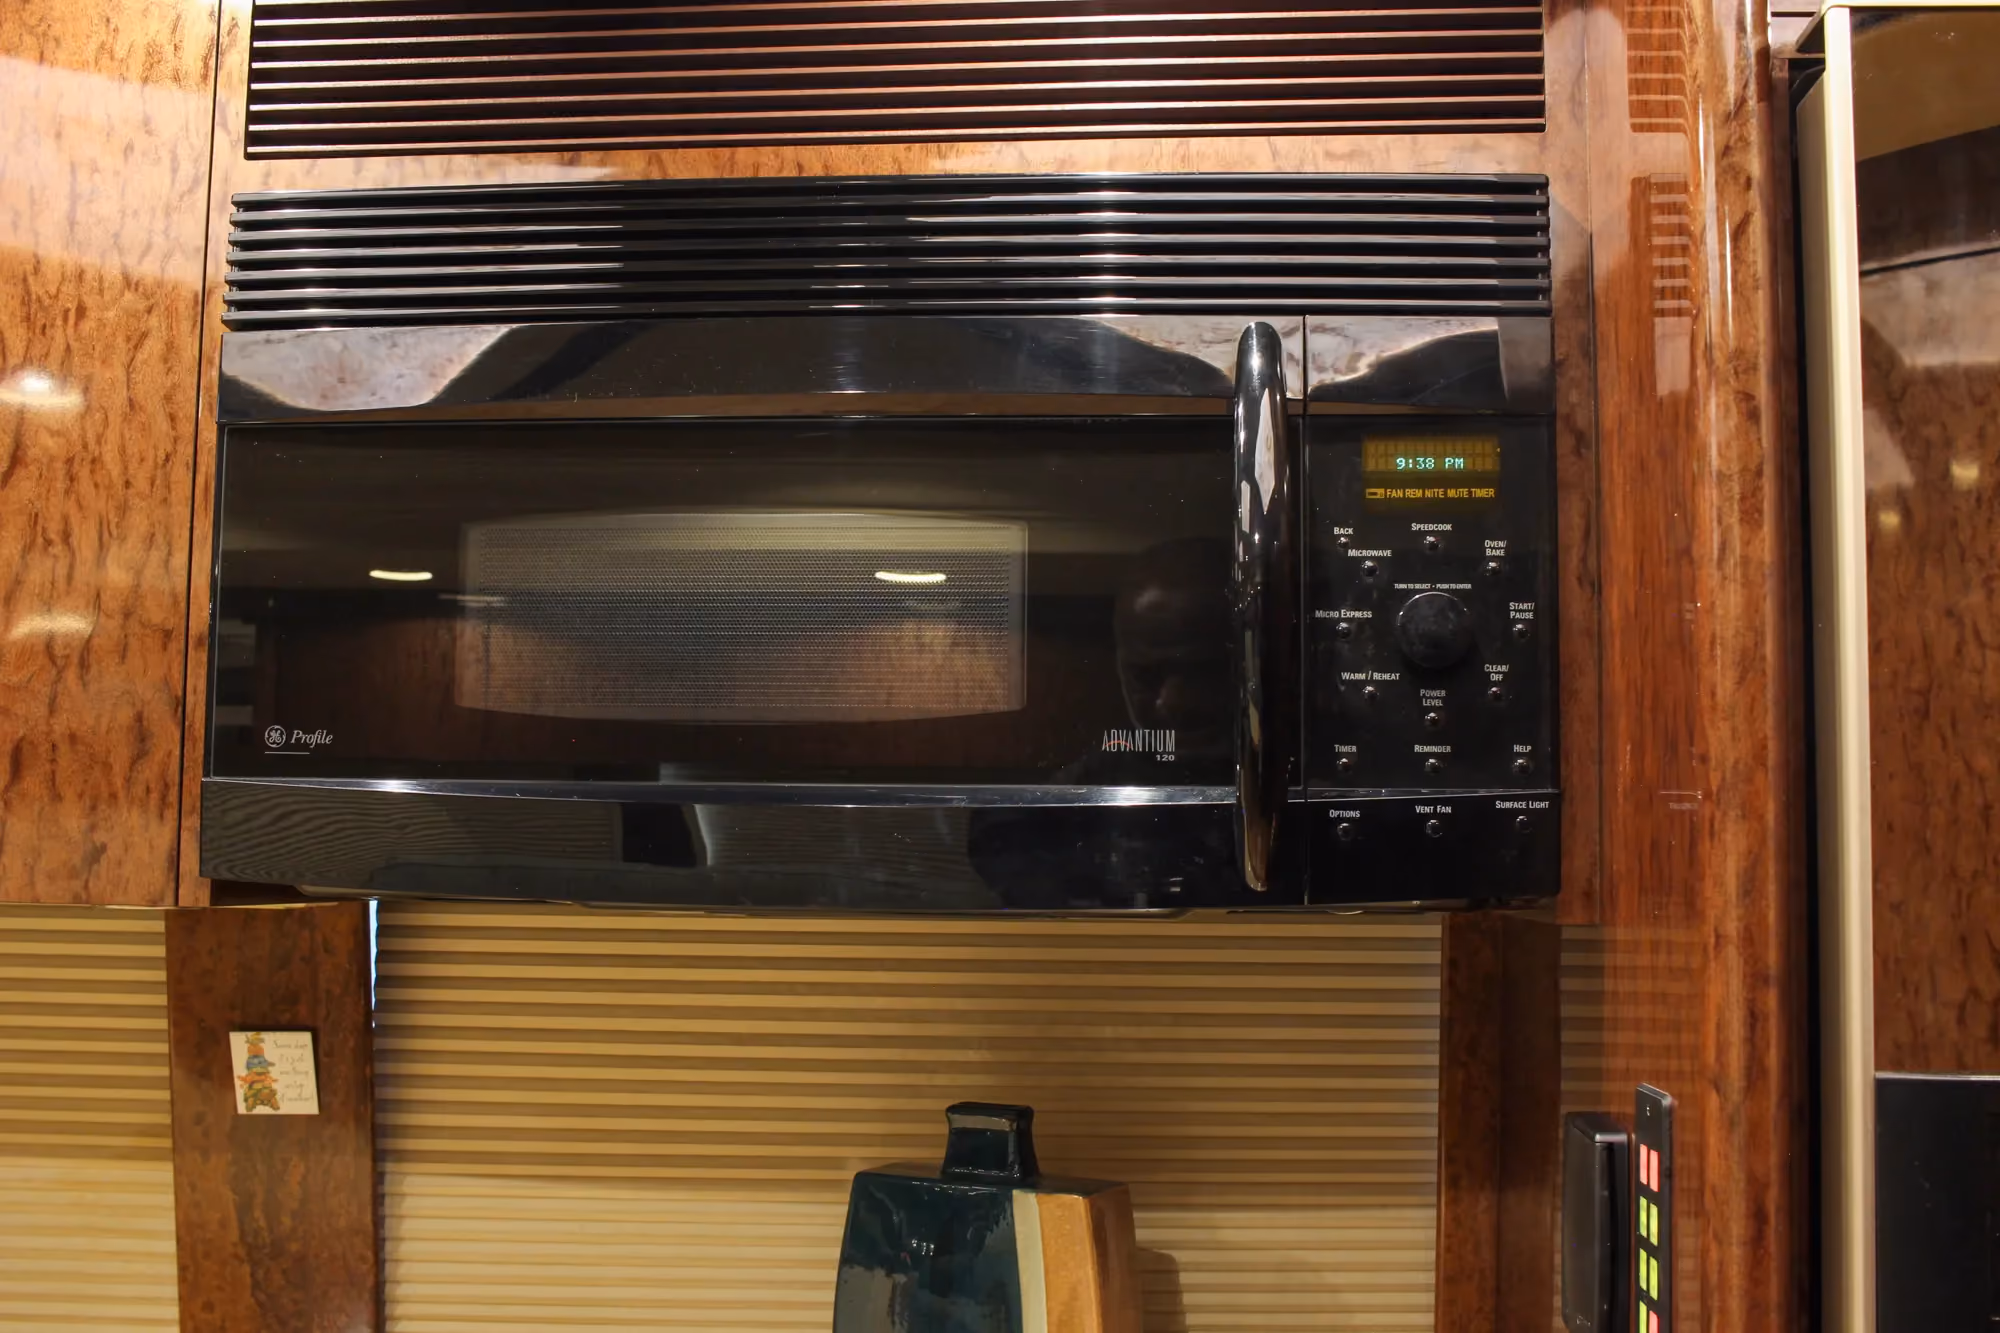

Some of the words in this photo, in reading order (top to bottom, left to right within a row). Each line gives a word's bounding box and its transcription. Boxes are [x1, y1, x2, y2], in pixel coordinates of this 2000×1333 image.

[1396, 457, 1435, 470] 9:38
[1445, 457, 1464, 470] PM
[1386, 488, 1403, 498] FAN
[1405, 488, 1423, 498] REM
[1424, 488, 1445, 498] NITE
[1447, 488, 1469, 498] MUTE
[1470, 488, 1495, 498] TIMER
[1334, 527, 1354, 535] BACK
[1411, 523, 1452, 531] SPEEDCOOK
[1484, 540, 1507, 548] OVEN/
[1347, 549, 1392, 557] MICROWAVE
[1486, 548, 1505, 556] BAKE
[1509, 602, 1534, 611] START/
[1315, 610, 1340, 618] MICRO
[1341, 610, 1373, 618] EXPRESS
[1510, 611, 1534, 619] PAUSE
[1484, 664, 1509, 673] CLEAR/
[1341, 672, 1366, 681] WARM
[1373, 672, 1400, 681] REHEAT
[1490, 673, 1504, 682] OFF
[1419, 689, 1446, 697] POWER
[1423, 698, 1443, 706] LEVEL
[290, 729, 333, 748] Profile
[1101, 729, 1176, 753] ADVANTIUM
[1334, 745, 1357, 753] TIMER
[1414, 745, 1452, 753] REMINDER
[1513, 745, 1532, 753] HELP
[1495, 801, 1527, 809] SURFACE
[1528, 801, 1550, 809] LIGHT
[1329, 809, 1361, 818] OPTIONS
[1415, 805, 1434, 814] VENT
[1436, 805, 1452, 814] FAN
